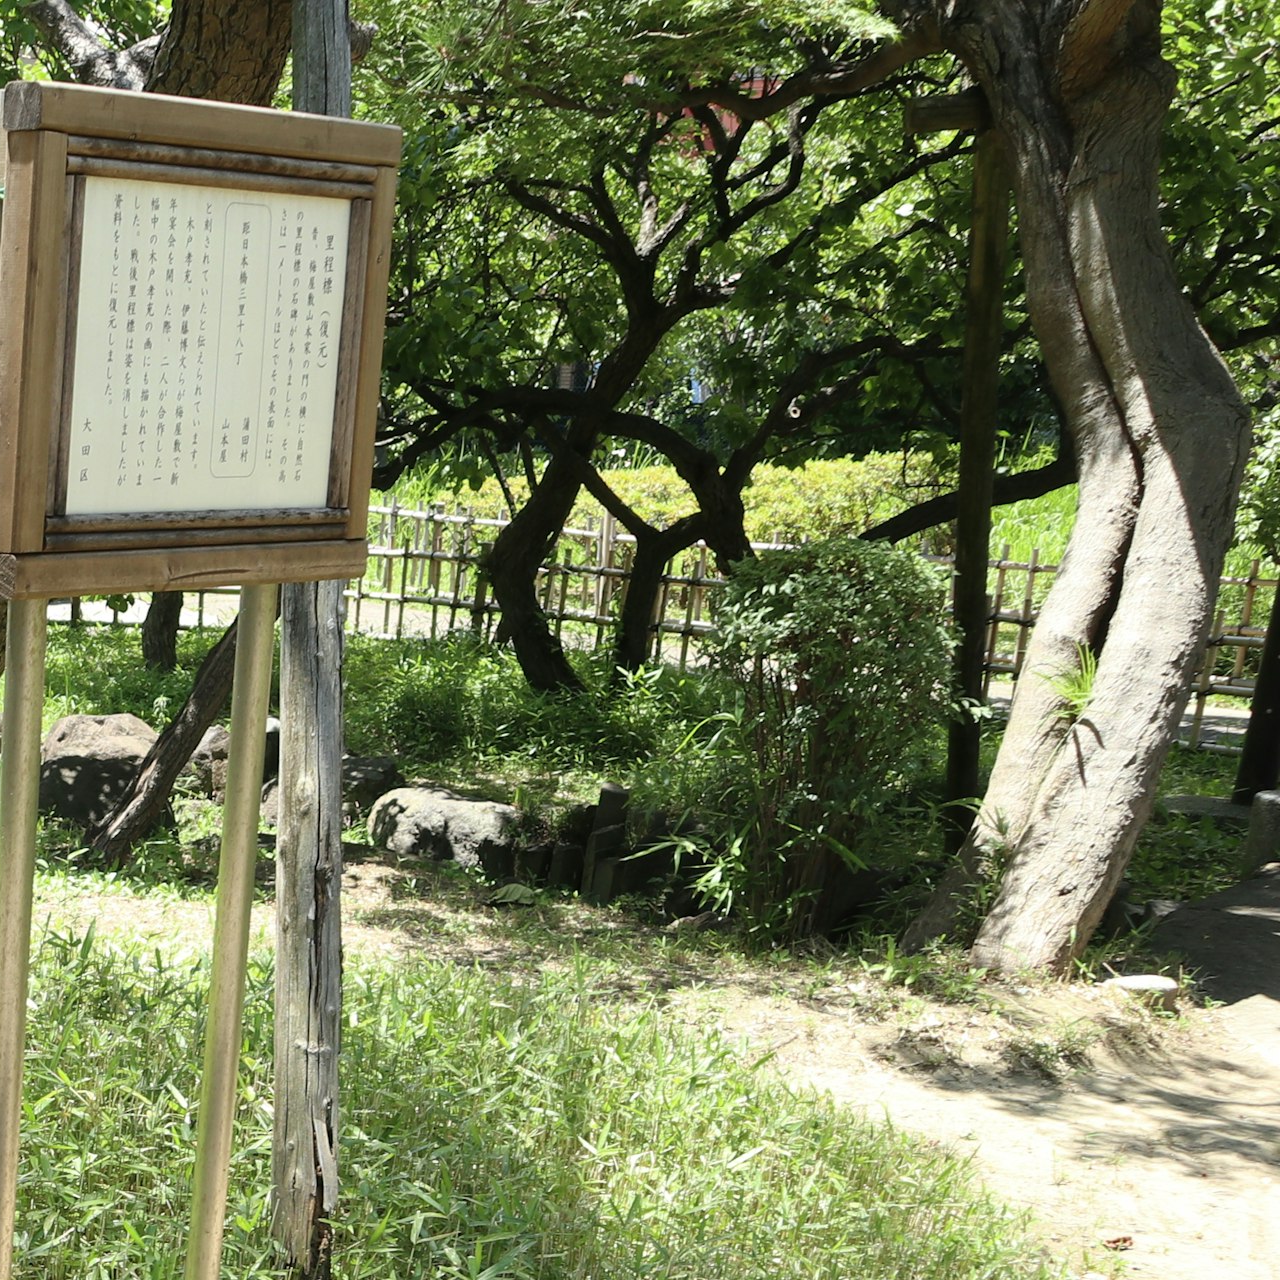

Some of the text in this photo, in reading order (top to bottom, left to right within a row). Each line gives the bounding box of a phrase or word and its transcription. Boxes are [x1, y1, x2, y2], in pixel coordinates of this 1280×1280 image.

[104, 193, 124, 405] 資料をもとに復元しました。
[190, 204, 213, 469] と刻されていたと伝えられています。
[79, 417, 92, 482] 大田区
[219, 418, 230, 463] 山本屋
